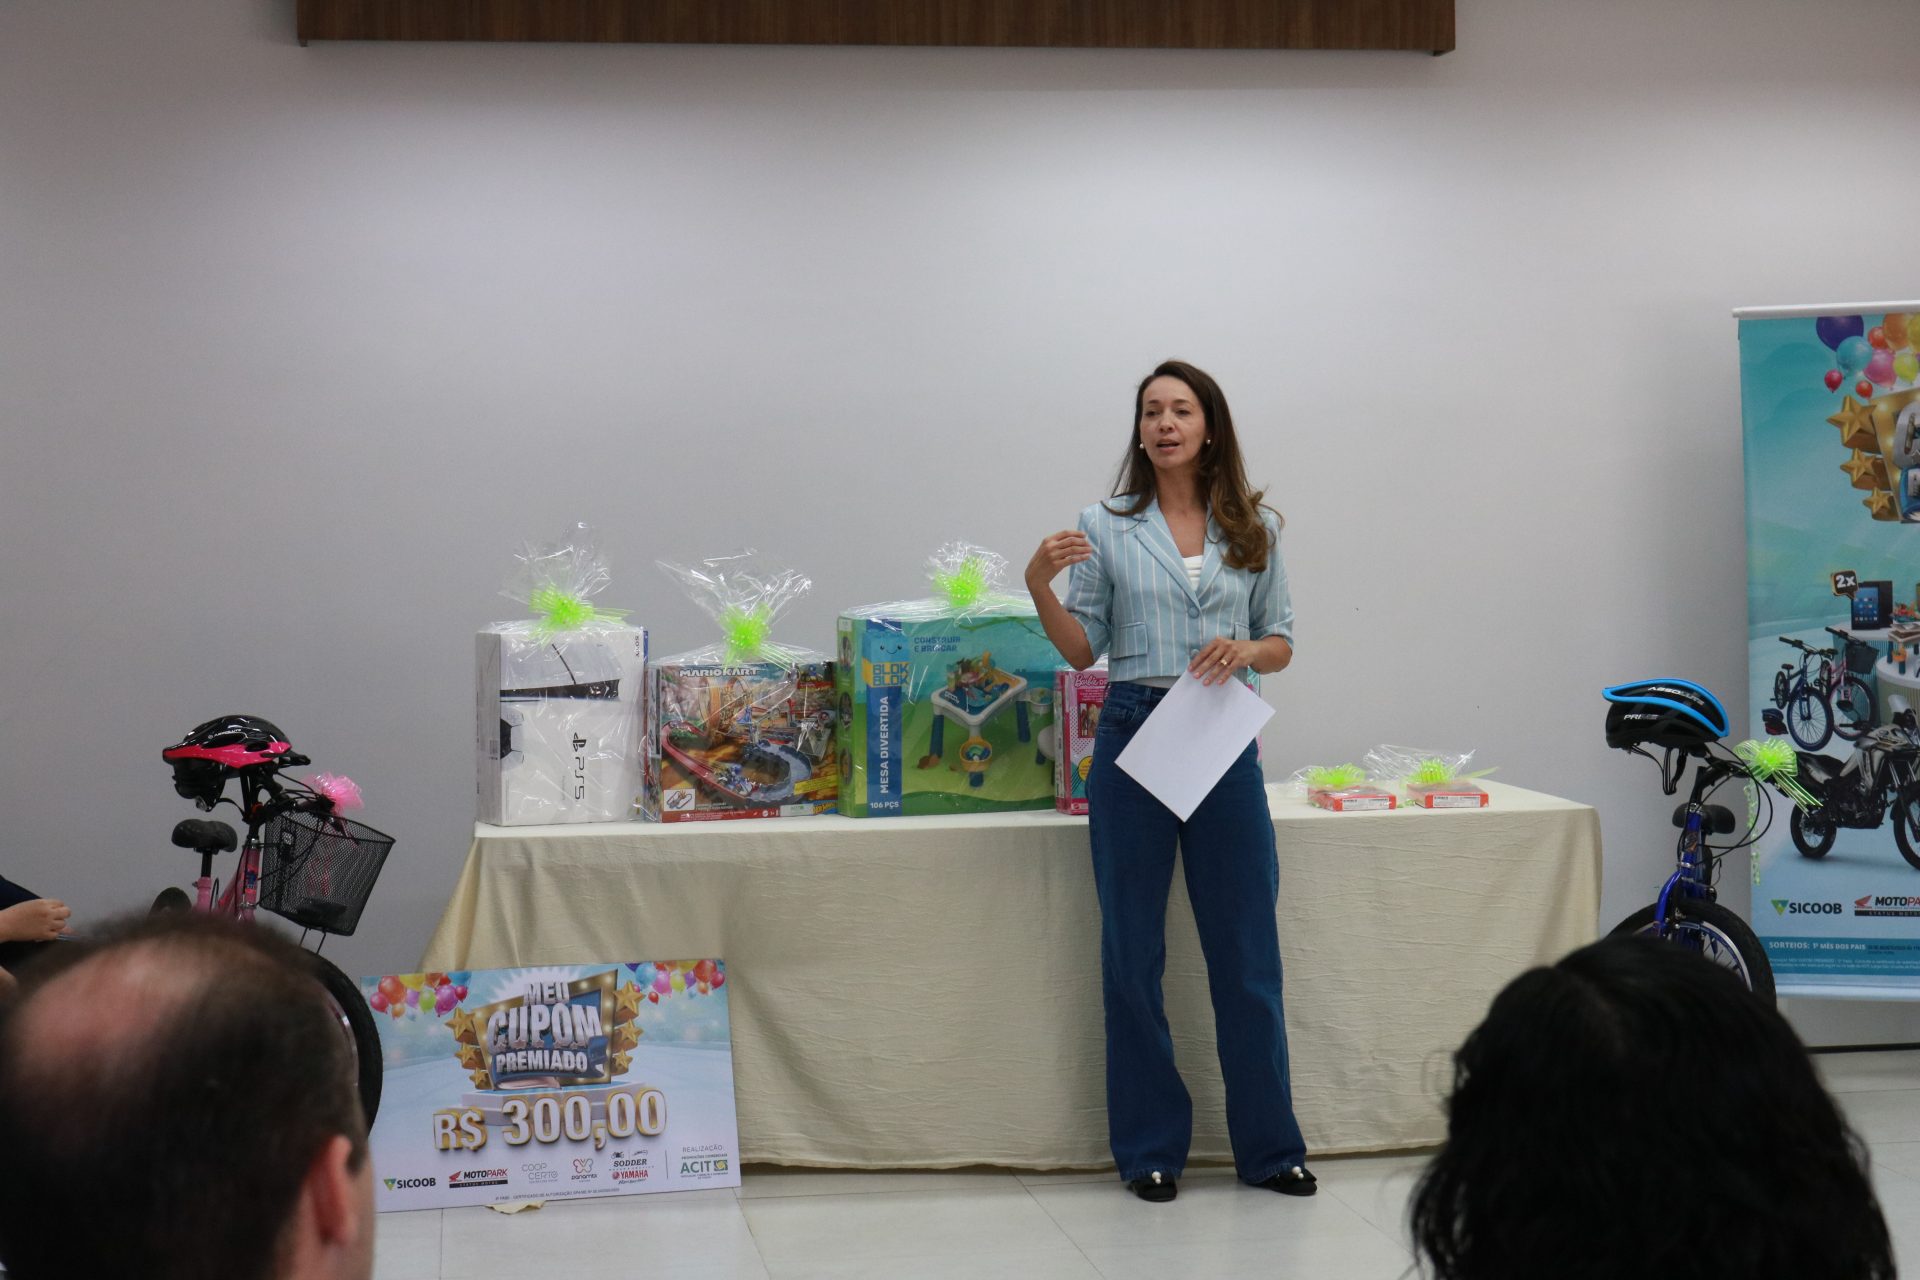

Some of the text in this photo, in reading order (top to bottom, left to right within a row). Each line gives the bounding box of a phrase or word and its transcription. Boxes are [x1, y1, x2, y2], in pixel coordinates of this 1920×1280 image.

[1835, 574, 1856, 588] 2x
[914, 636, 960, 644] CONSTRUIR
[873, 663, 909, 674] BLOK
[873, 675, 908, 686] BLOK
[1074, 673, 1098, 688] Barbie
[880, 696, 889, 794] MESA DIVERTIDA
[574, 756, 585, 800] PS5
[1788, 902, 1842, 915] SICOOB
[523, 981, 571, 1006] MEU
[486, 1004, 602, 1050] CUPOM
[495, 1050, 589, 1074] PREMIADO
[433, 1088, 667, 1151] R$ 300,00
[682, 1144, 723, 1153] REALIZAÇÃO
[522, 1162, 548, 1172] COOP
[613, 1158, 648, 1167] SODDER
[680, 1160, 712, 1174] ACIT
[463, 1168, 509, 1180] MOTOPARK
[528, 1171, 559, 1181] CERTO
[620, 1169, 649, 1180] YAMAHA
[397, 1177, 437, 1189] SICOOB
